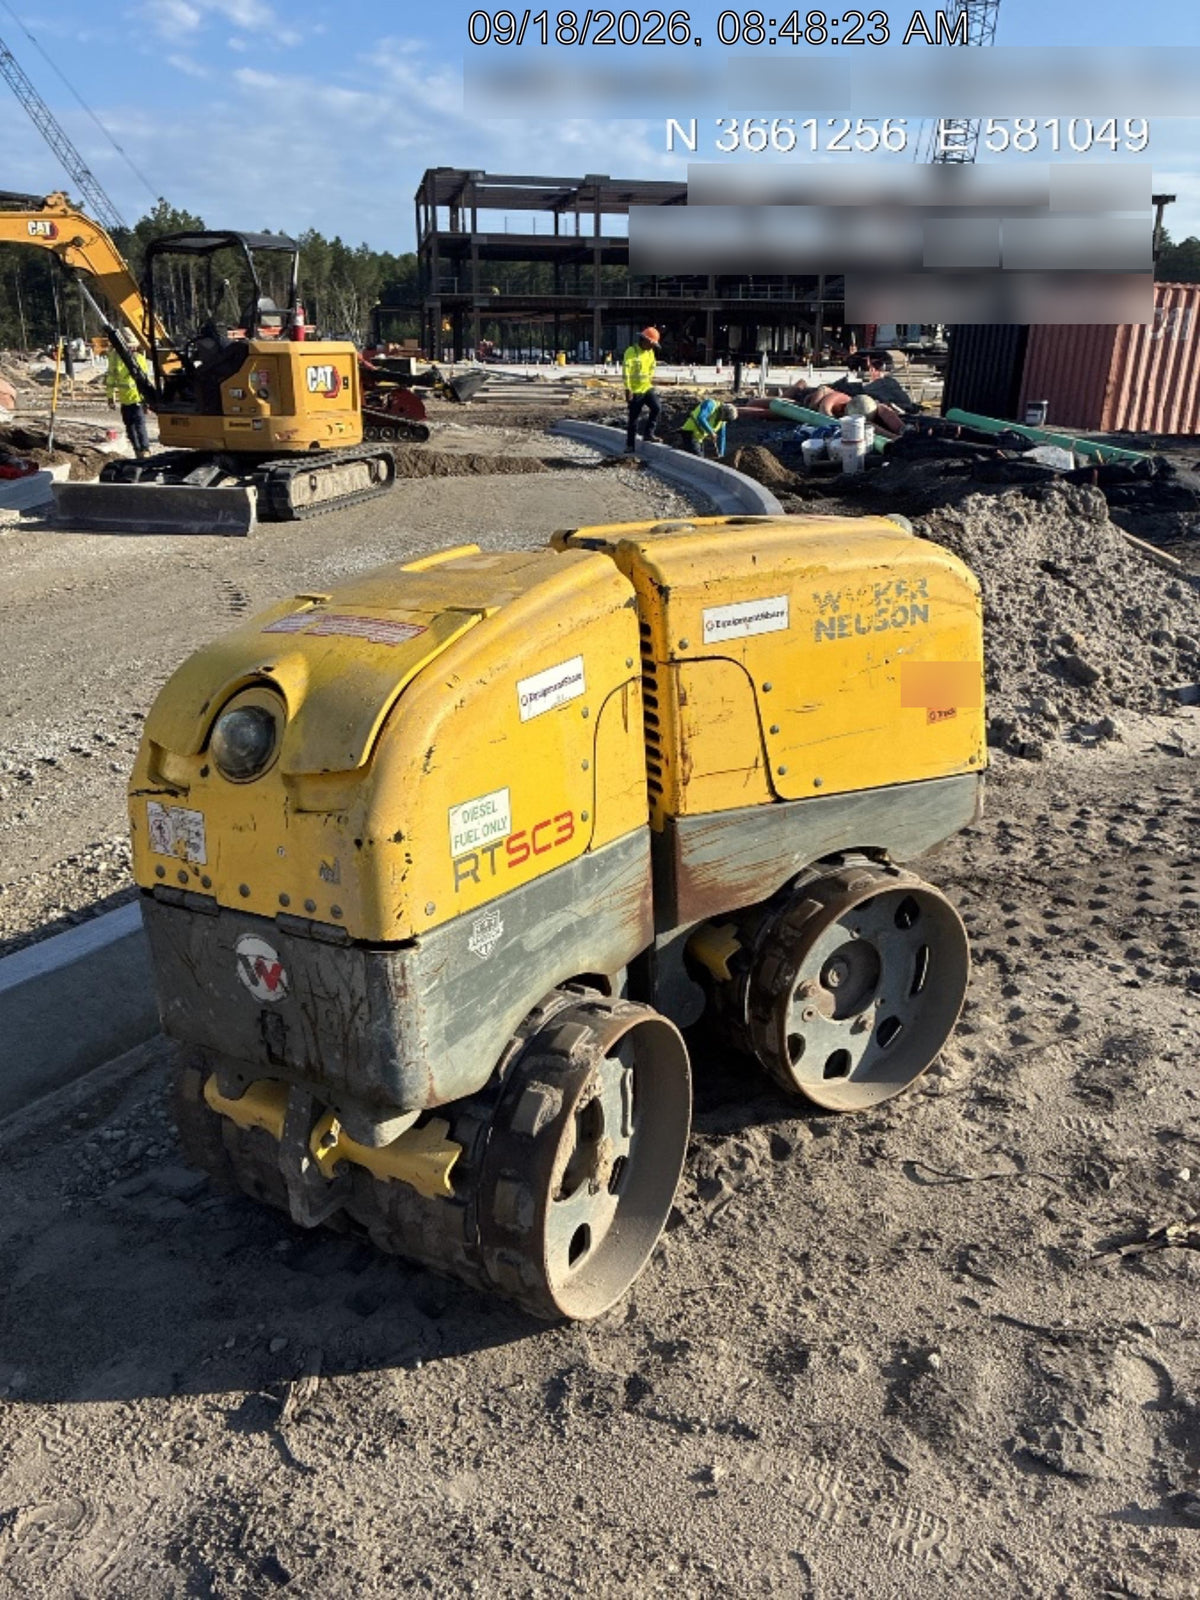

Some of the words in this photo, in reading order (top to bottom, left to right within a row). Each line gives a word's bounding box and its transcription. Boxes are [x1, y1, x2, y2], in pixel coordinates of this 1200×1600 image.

[27, 220, 52, 236] CAT
[306, 366, 335, 393] CAT
[814, 604, 929, 642] NEUSON
[462, 800, 498, 824] DIESEL
[454, 828, 481, 850] FUEL
[482, 816, 508, 838] ONLY
